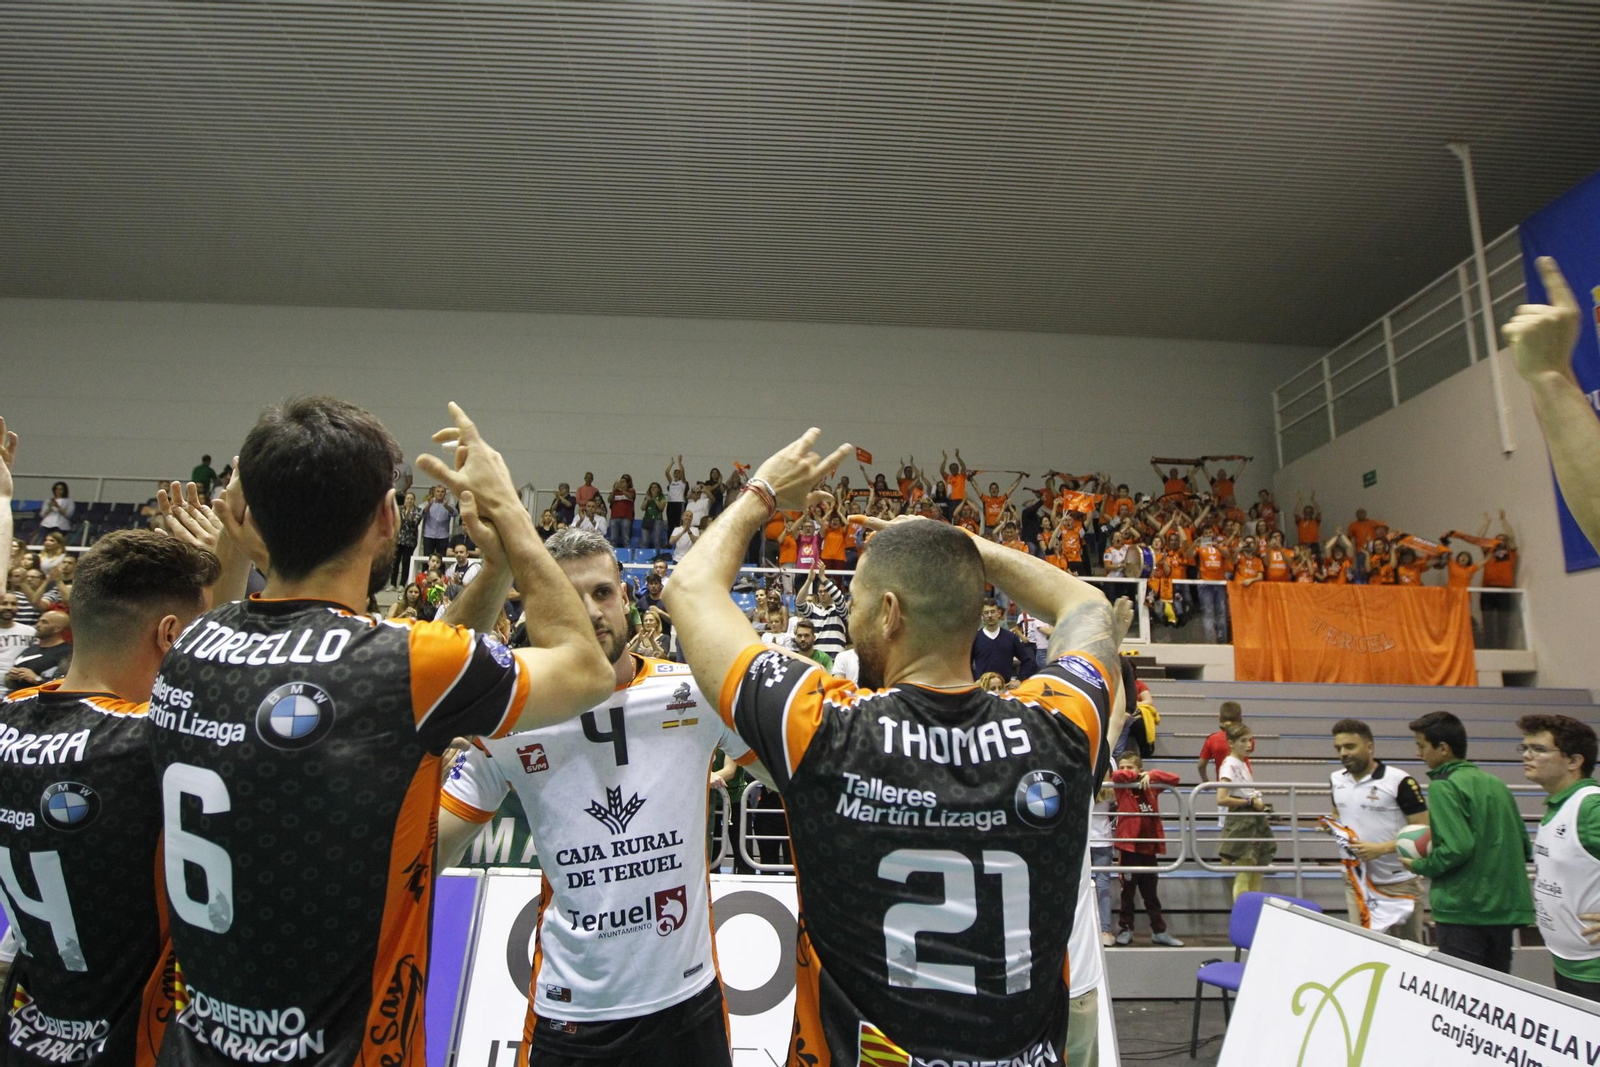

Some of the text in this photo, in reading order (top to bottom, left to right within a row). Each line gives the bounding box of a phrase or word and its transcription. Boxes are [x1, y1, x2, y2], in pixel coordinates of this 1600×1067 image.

[183, 620, 352, 666] TORCELLO
[1311, 616, 1396, 654] TERUEL
[151, 671, 194, 709] alleres
[148, 696, 246, 747] artín Lizaga
[580, 706, 629, 767] 4
[878, 715, 1032, 767] THOMAS
[843, 771, 938, 808] Talleres
[835, 793, 1008, 832] Martín Lizaga
[162, 762, 234, 935] 6
[556, 830, 684, 866] CAJA RURAL
[566, 853, 683, 889] DE TERUEL
[567, 896, 652, 932] Teruel
[598, 922, 653, 940] AYUNTAMIENTO
[877, 849, 1033, 995] 21
[21, 1004, 110, 1040] GOBIERNO
[1399, 971, 1418, 995] LA
[1419, 980, 1516, 1035] ALMAZARA
[1520, 1017, 1550, 1047] DE
[1550, 1029, 1580, 1060] LA
